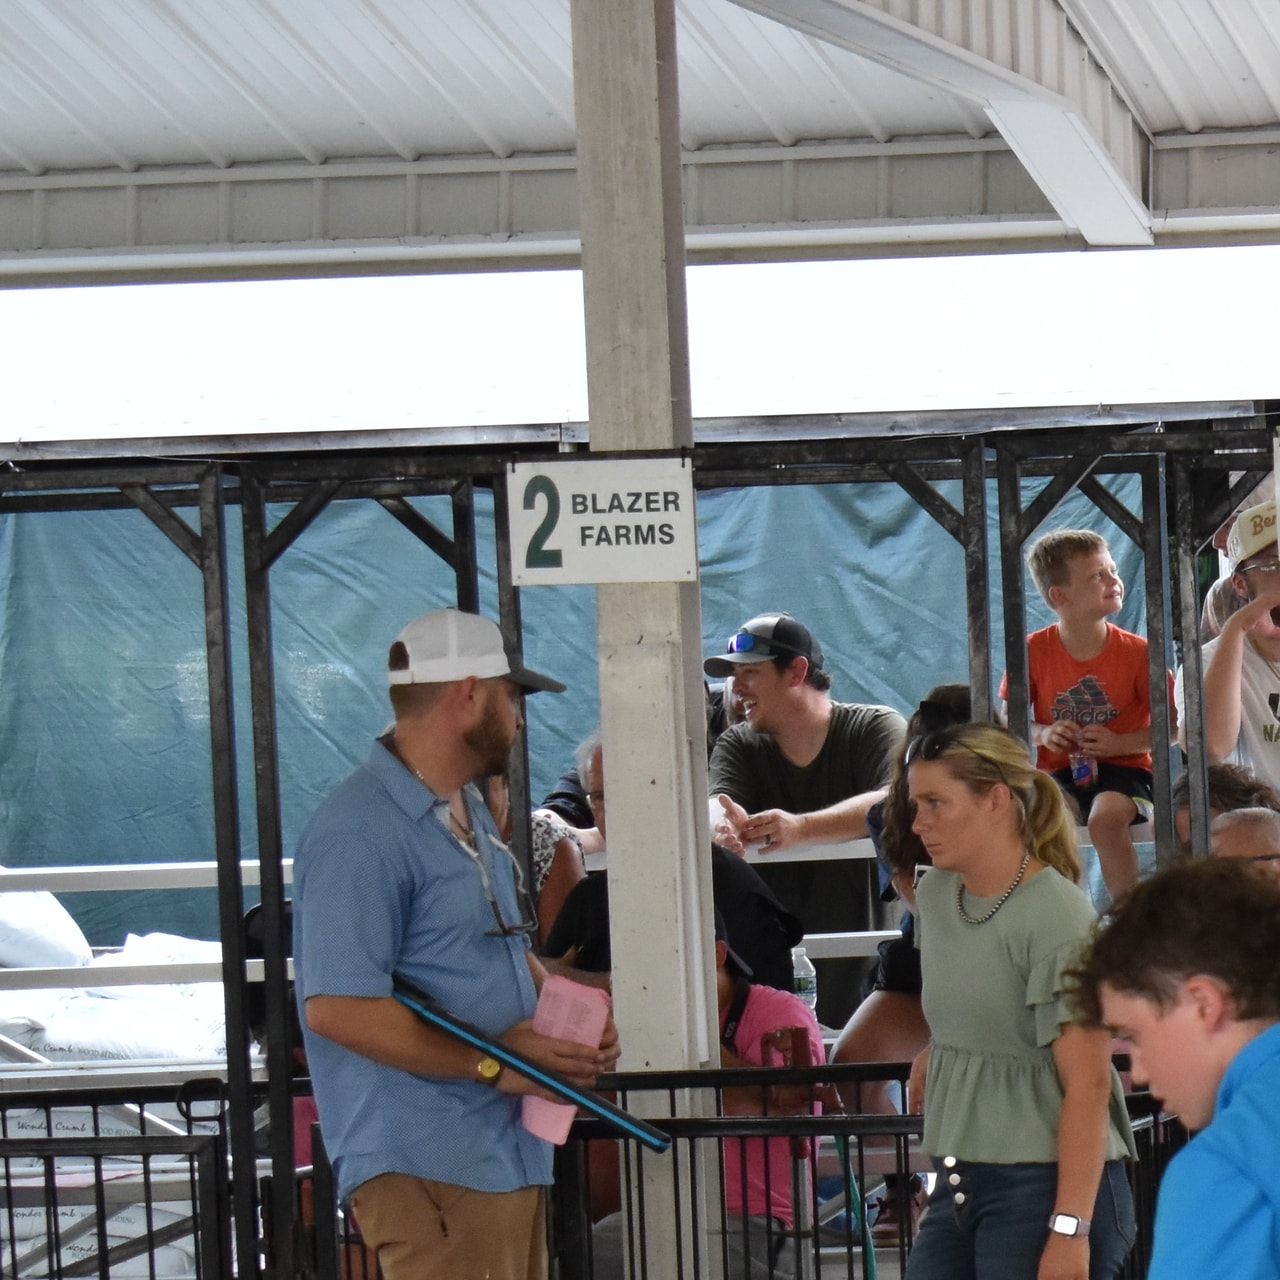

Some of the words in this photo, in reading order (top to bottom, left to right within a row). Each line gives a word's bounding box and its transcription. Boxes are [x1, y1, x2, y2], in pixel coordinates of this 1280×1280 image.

[572, 491, 680, 514] BLAZER
[523, 474, 563, 568] 2
[580, 523, 675, 546] FARMS
[1050, 704, 1120, 726] adidas
[17, 1121, 48, 1131] Wonde
[55, 1122, 87, 1132] Crumb
[14, 1208, 42, 1219] onder
